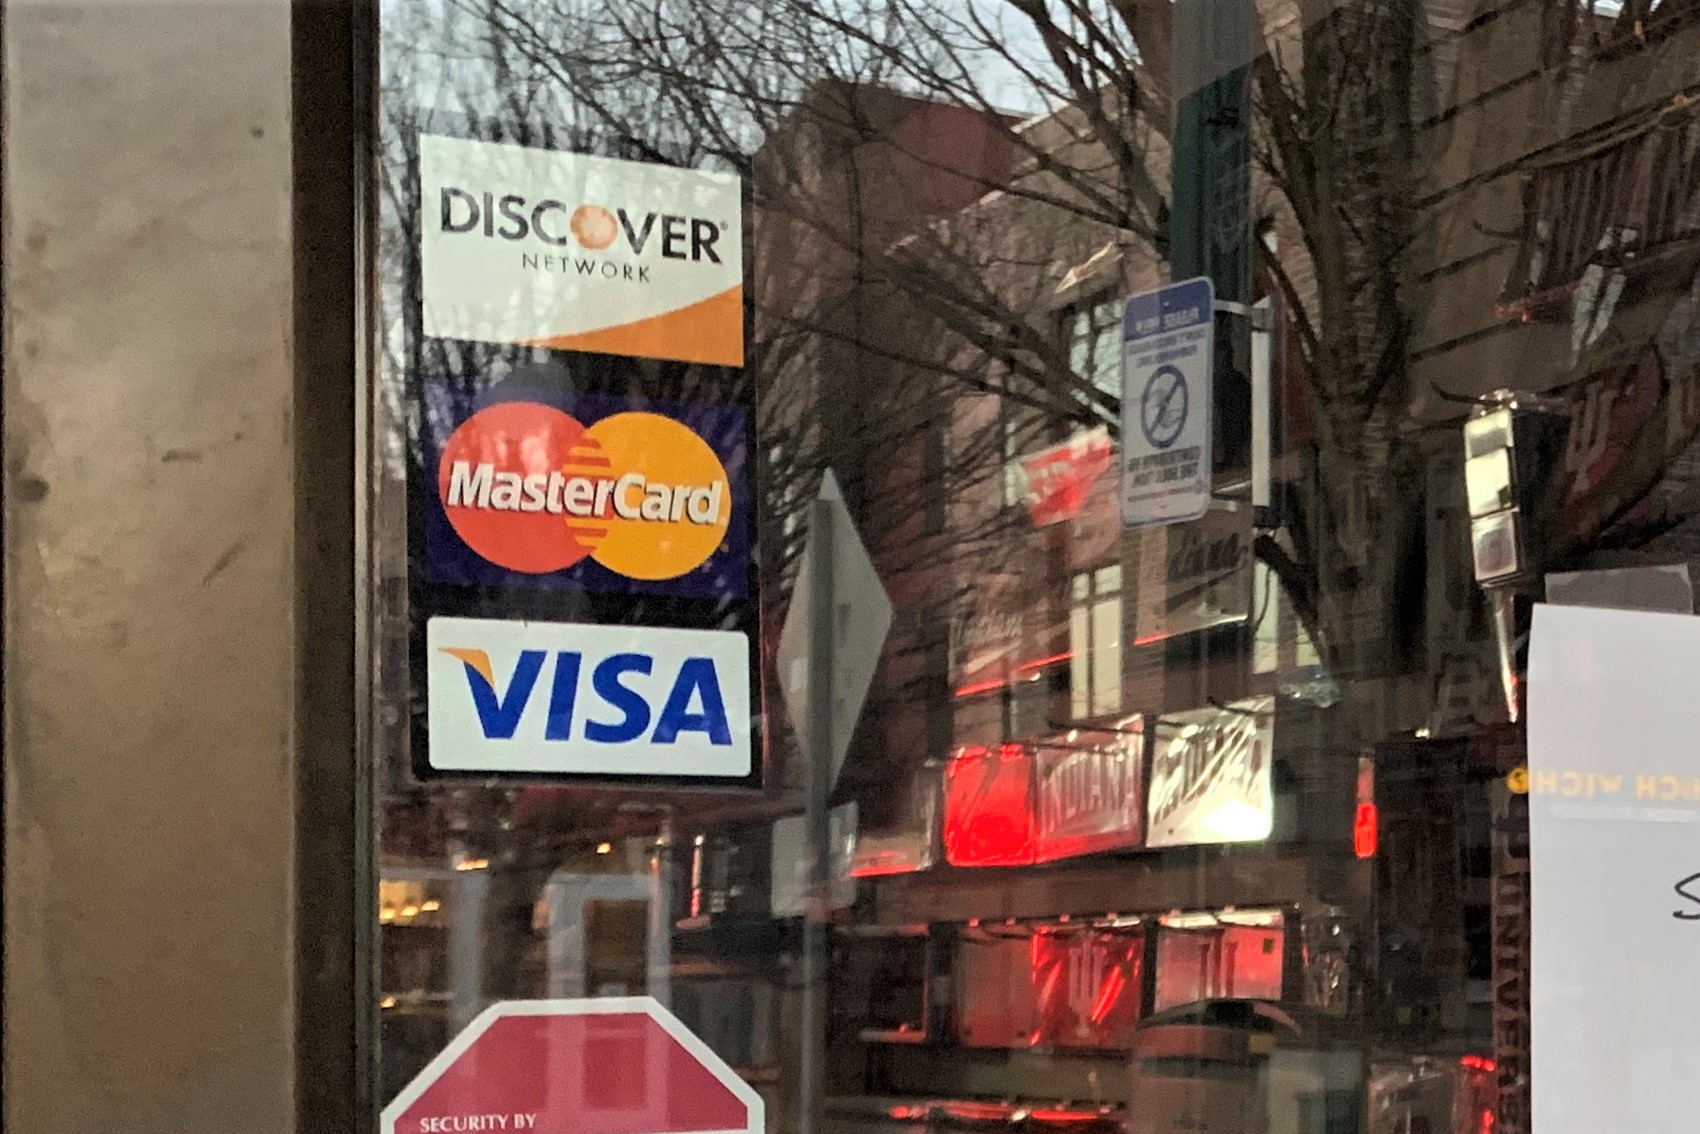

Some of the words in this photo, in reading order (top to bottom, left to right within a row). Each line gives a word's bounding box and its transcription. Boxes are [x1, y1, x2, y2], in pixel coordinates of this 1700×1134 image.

[440, 187, 722, 265] DISCOVER
[522, 252, 651, 283] NETWORK
[447, 460, 723, 526] MasterCard
[438, 647, 733, 746] VISA
[420, 1114, 509, 1133] SECURITY
[513, 1113, 537, 1130] BY
